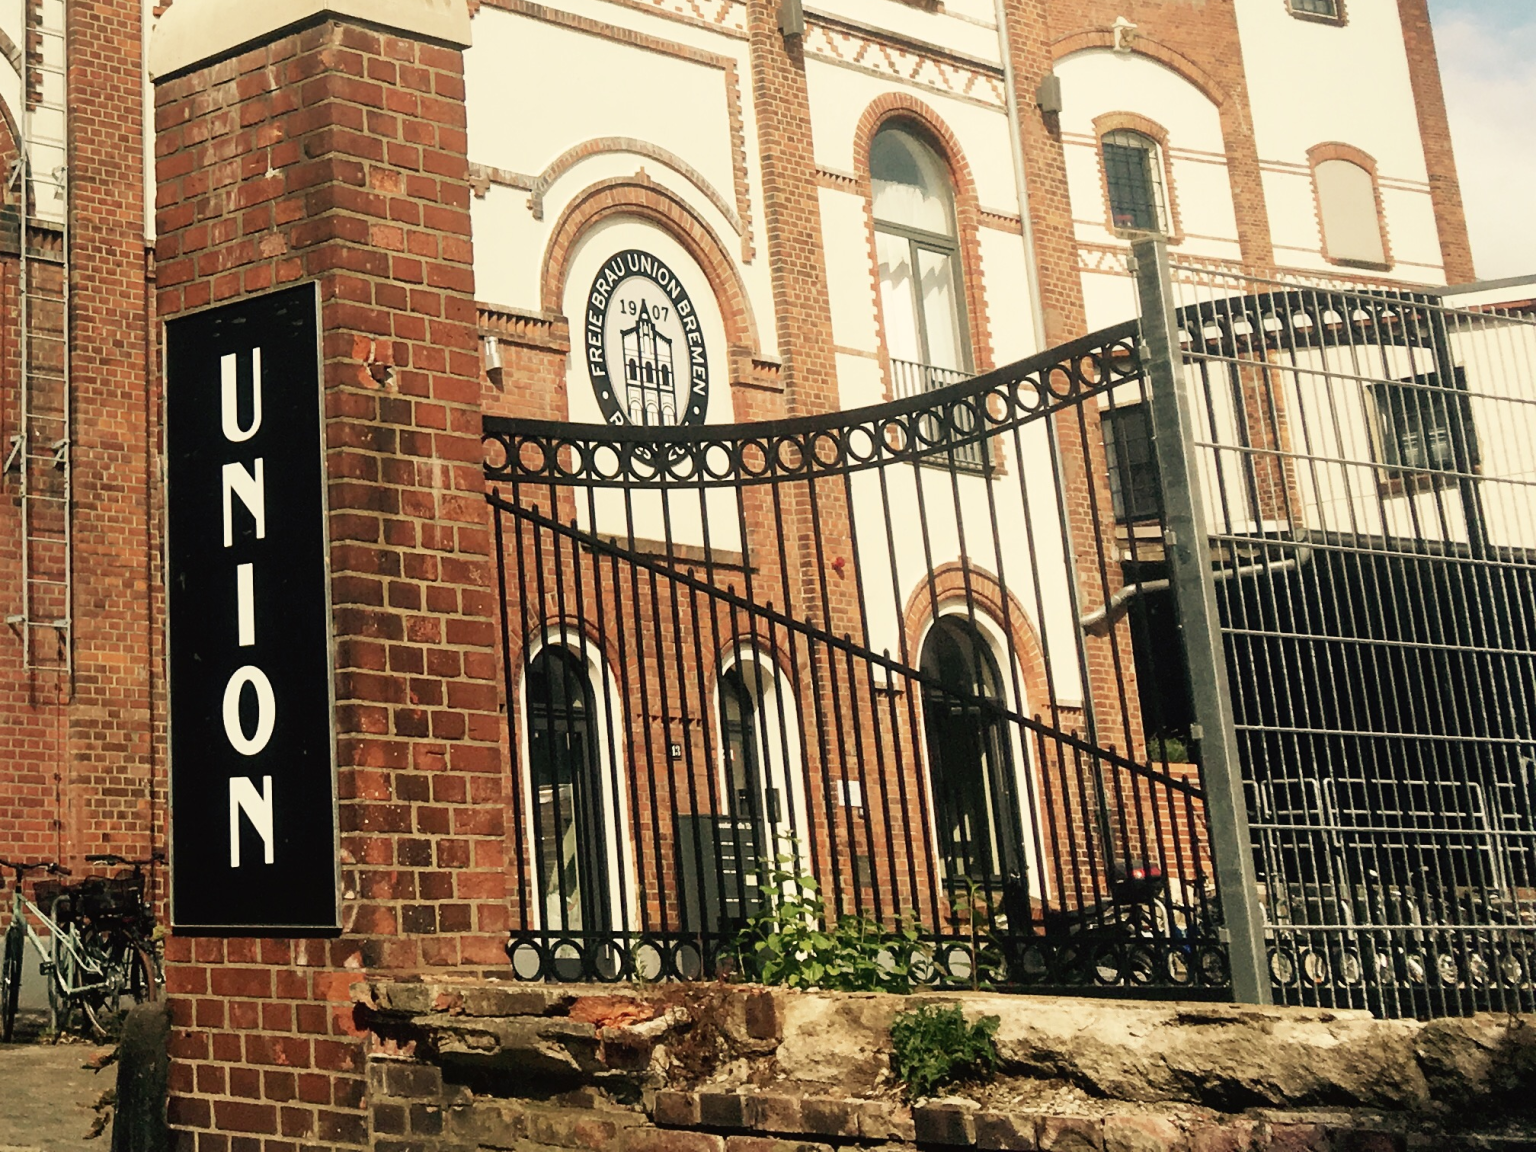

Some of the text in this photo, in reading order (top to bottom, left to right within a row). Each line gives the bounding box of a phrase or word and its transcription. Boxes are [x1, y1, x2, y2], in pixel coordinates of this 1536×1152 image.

[588, 253, 706, 396] FREIE BRAU UNION BREMEN
[619, 298, 669, 323] 19 07
[220, 346, 276, 869] UNION
[671, 744, 681, 757] 13
